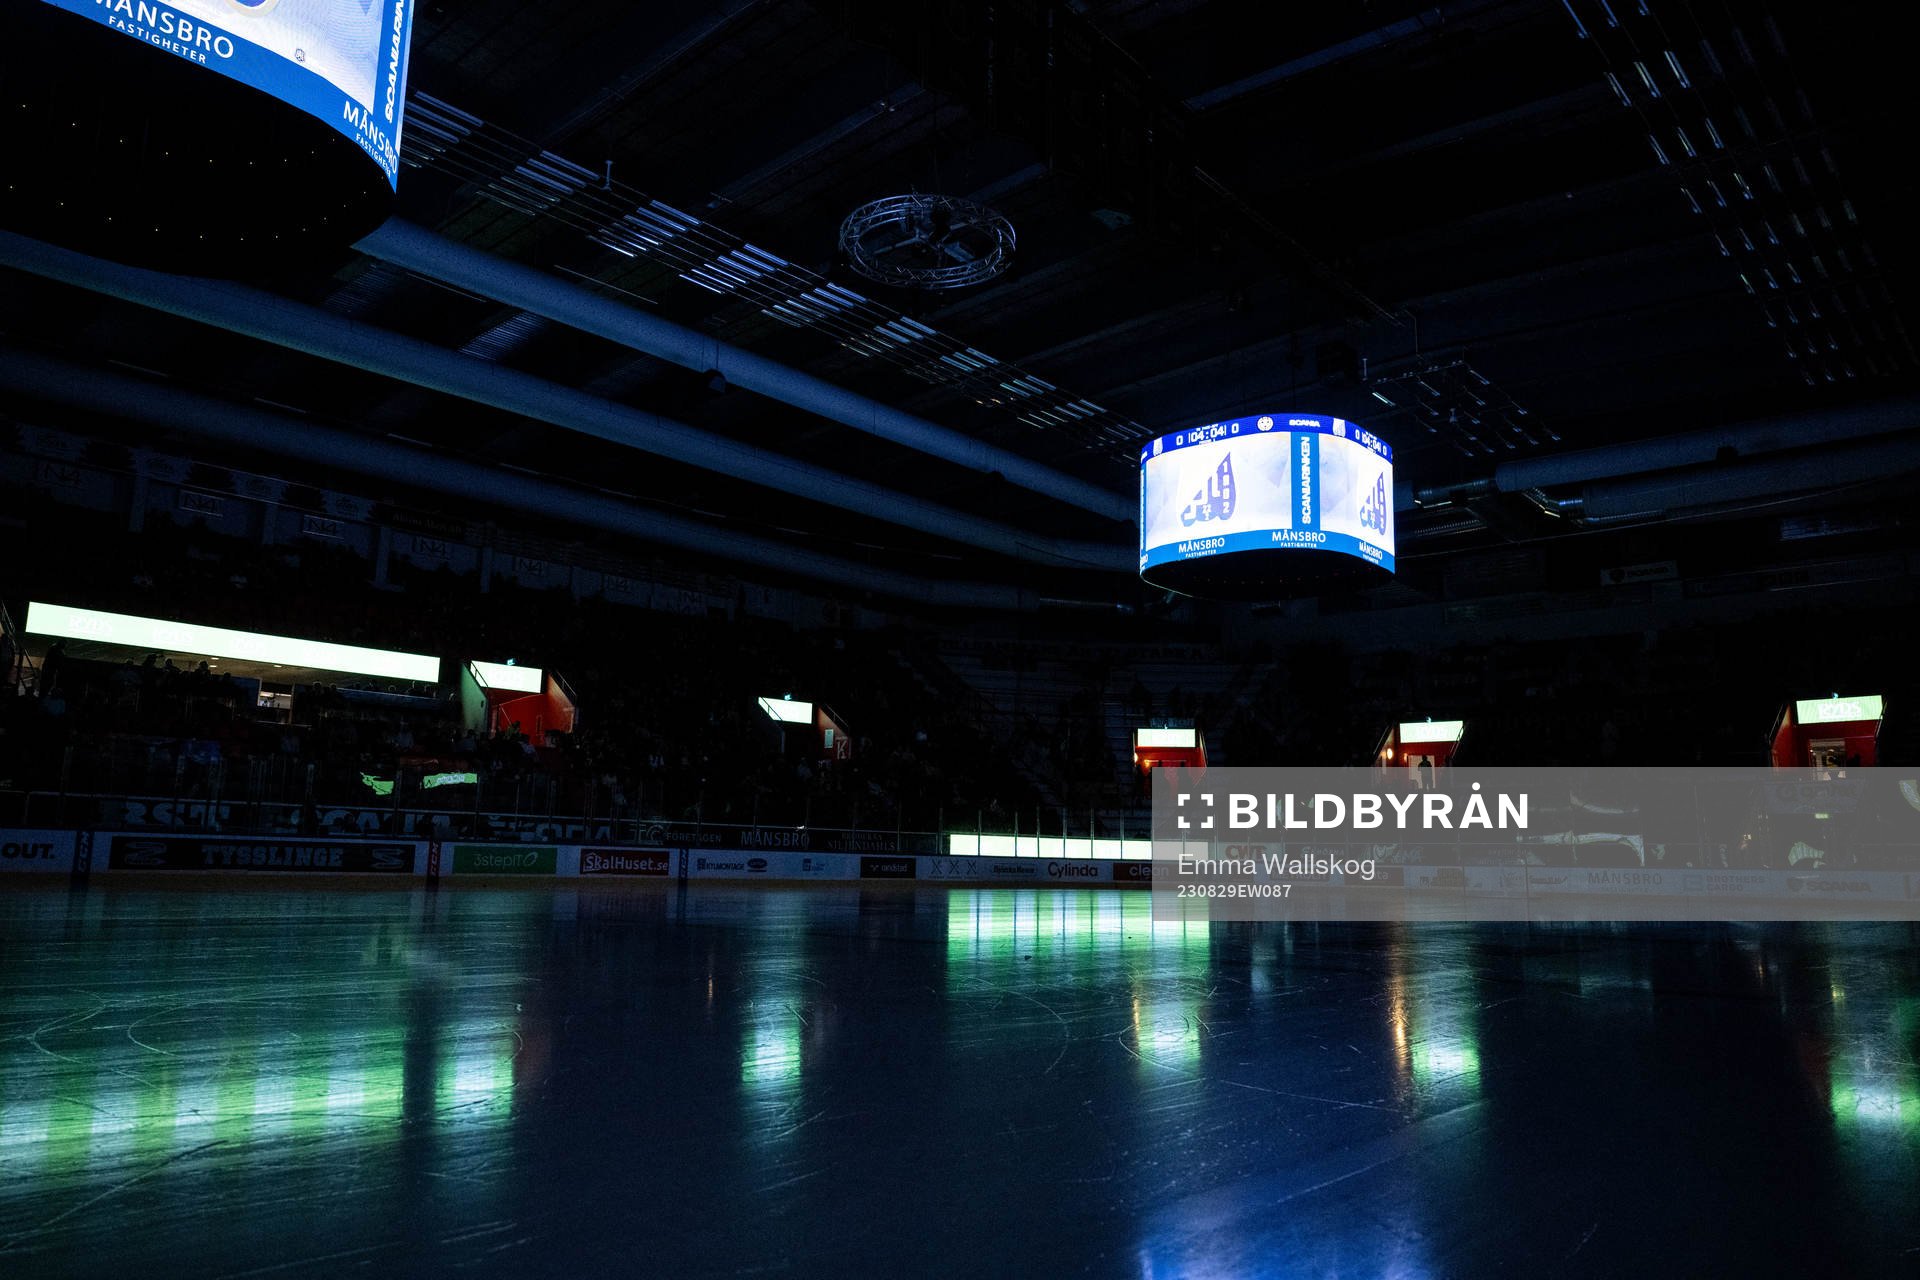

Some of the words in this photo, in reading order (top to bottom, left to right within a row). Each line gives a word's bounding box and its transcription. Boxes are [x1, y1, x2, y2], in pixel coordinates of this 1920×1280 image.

[96, 0, 234, 58] ÅNSBRO
[108, 15, 206, 64] FASTIGHETER
[343, 100, 398, 174] MÅNSBRO
[1231, 422, 1240, 434] 0
[1289, 419, 1320, 427] SCANIA
[1301, 436, 1311, 525] SCANIARINKEN
[1178, 537, 1225, 553] MÅNSBRO
[1272, 529, 1326, 543] MÅNSBRO
[740, 828, 810, 848] MÅNSBRO
[201, 844, 344, 867] TYSSLINGE
[584, 853, 669, 872] SkalHuset.se
[1048, 862, 1098, 879] Cylinda
[1588, 870, 1663, 885] MÅNSBRO
[1806, 880, 1873, 893] SCANIA
